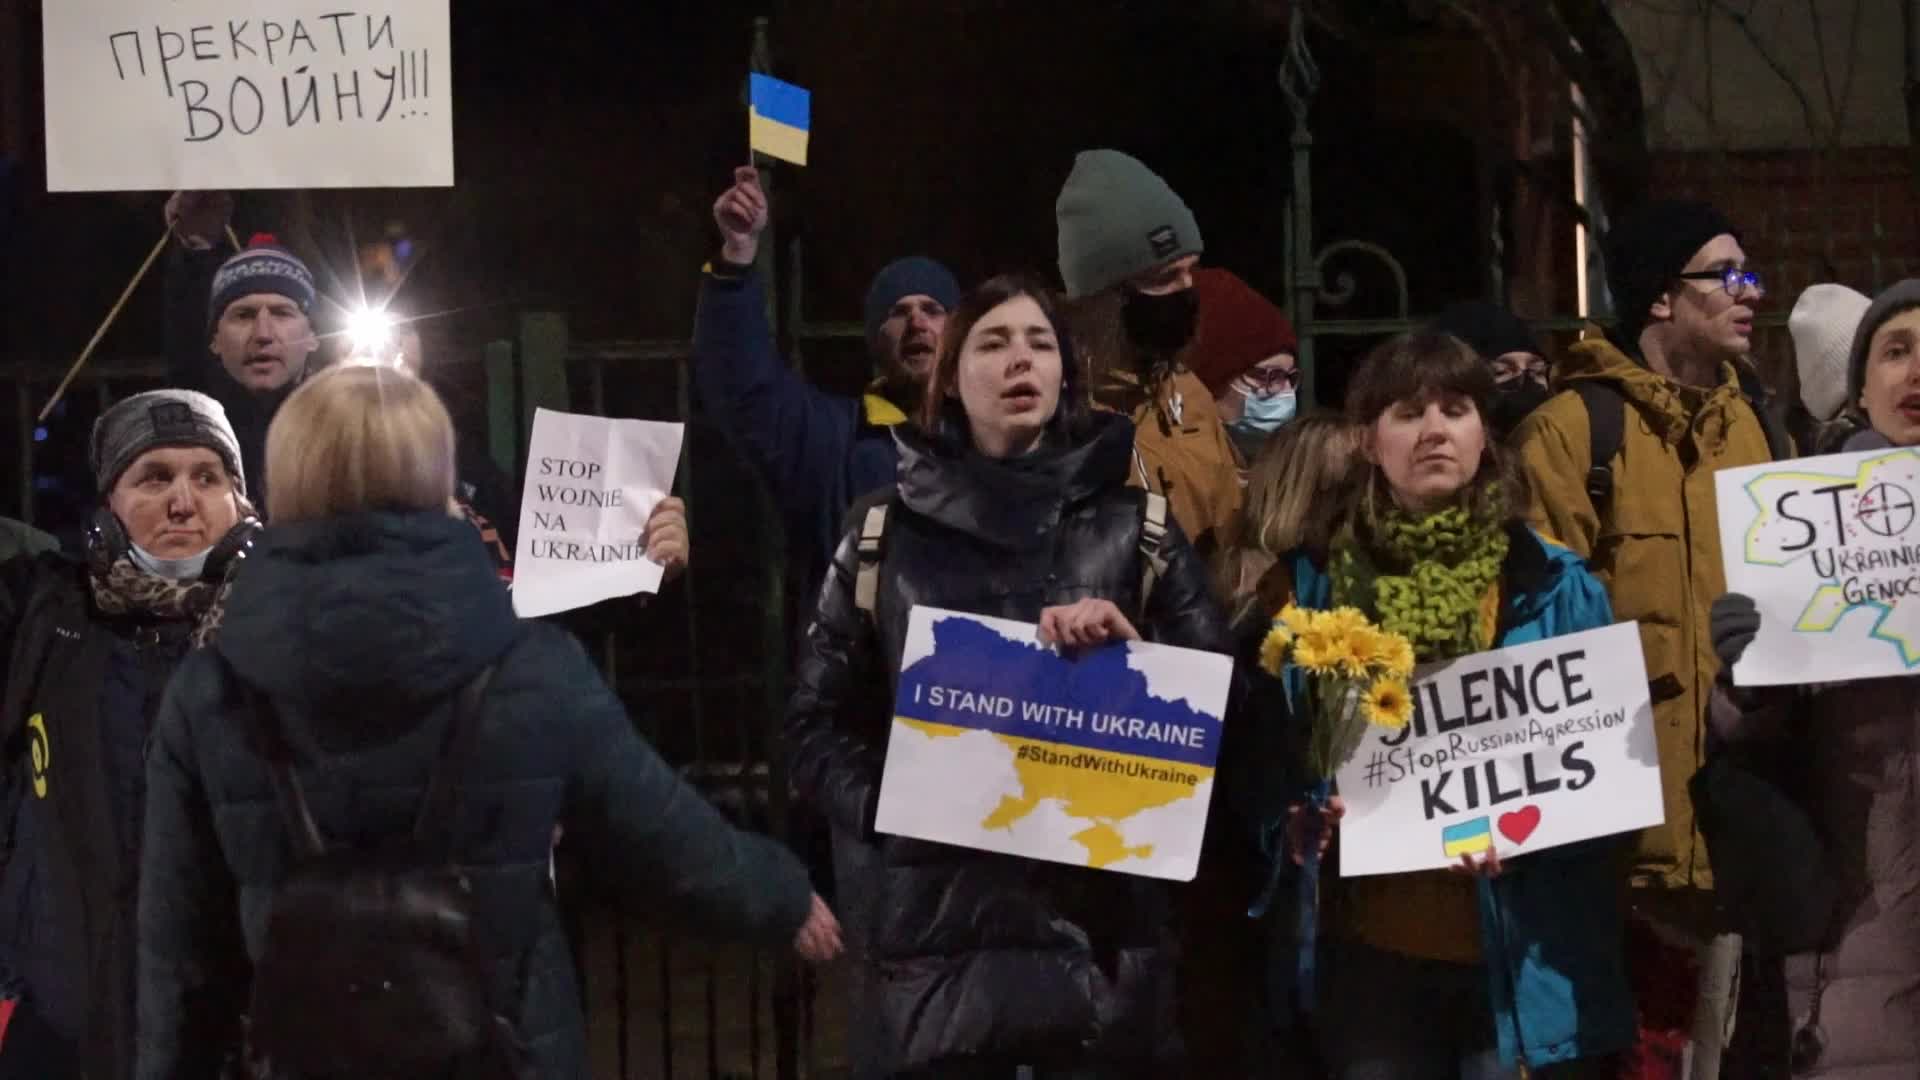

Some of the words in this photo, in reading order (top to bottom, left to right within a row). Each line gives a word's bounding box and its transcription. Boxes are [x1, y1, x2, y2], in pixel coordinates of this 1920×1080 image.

[110, 12, 394, 97] ПРЕКРАТИ
[178, 48, 428, 142] ВОЙНУ!!!
[540, 457, 601, 480] STOP
[533, 511, 567, 532] NA
[537, 485, 624, 508] WOJNIE
[914, 684, 921, 704] I
[928, 687, 1013, 718] STAND
[1021, 701, 1085, 730] WITH
[1091, 712, 1206, 749] UKRAINE
[1016, 744, 1199, 787] #StandWithUkraine
[1420, 741, 1597, 821] KILLS
